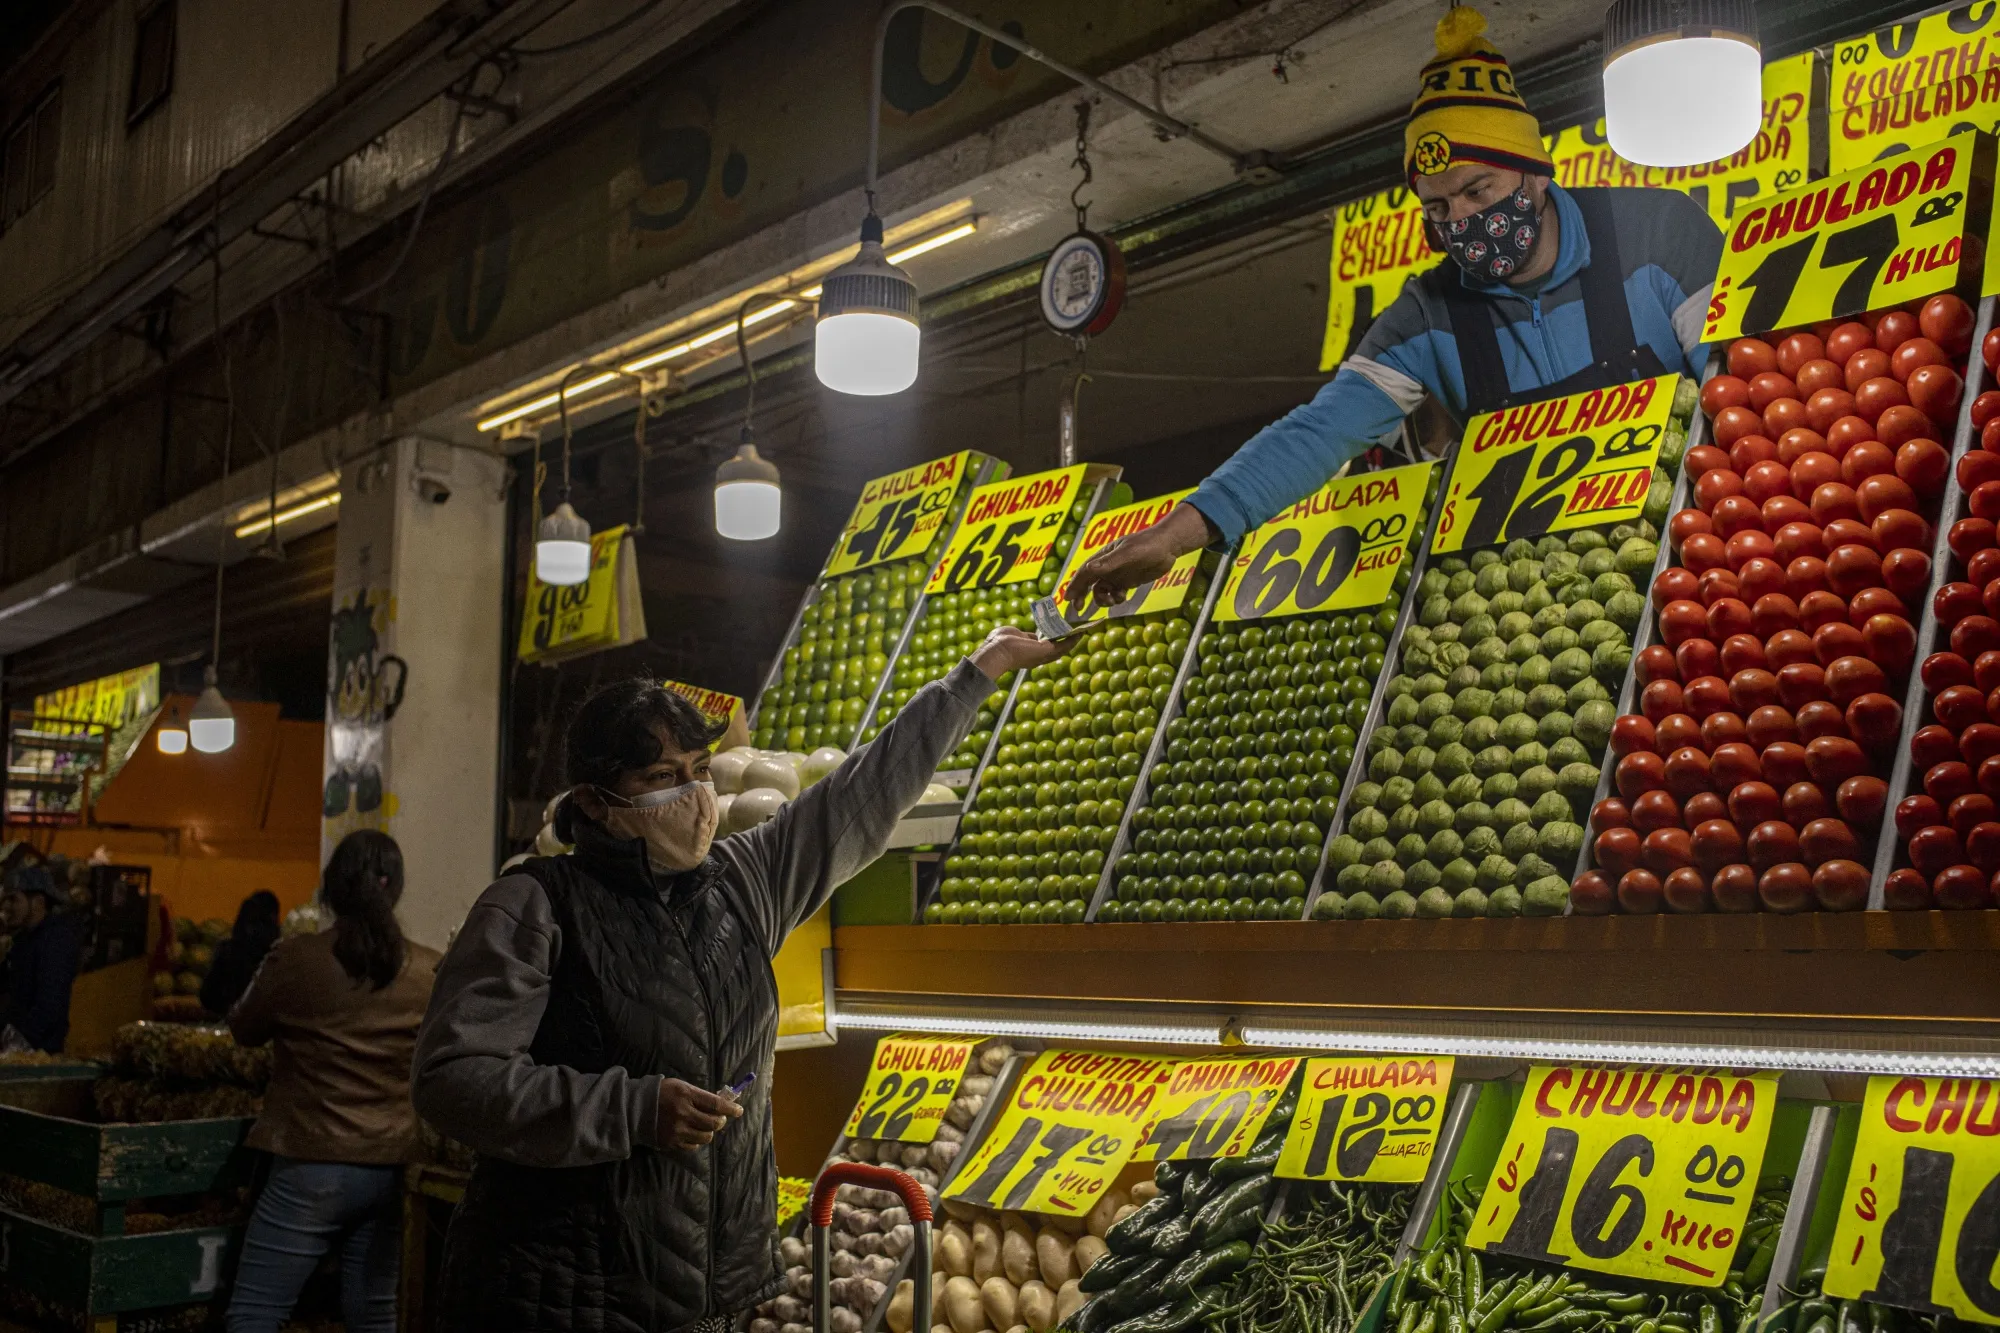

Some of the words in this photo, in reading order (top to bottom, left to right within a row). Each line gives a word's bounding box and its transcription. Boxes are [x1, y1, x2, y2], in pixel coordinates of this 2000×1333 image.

[1731, 147, 1957, 253] CHULADA
[1737, 212, 1899, 336] 17
[1883, 236, 1963, 285] KILO
[1474, 378, 1657, 453] CHULADA
[863, 454, 957, 505] CHULADA
[966, 474, 1070, 525] CHULADA
[1266, 476, 1400, 525] HULADA
[1461, 435, 1595, 549] 12
[1566, 468, 1652, 513] KILO
[846, 492, 923, 566] 45
[912, 512, 944, 537] KILO
[1083, 499, 1175, 550] CHULA
[945, 517, 1035, 591] 65
[1014, 542, 1053, 567] KILO
[1234, 525, 1361, 620] 60
[1354, 546, 1402, 578] KILO
[876, 1043, 967, 1073] CHULADA
[1169, 1059, 1295, 1096] CHULADA
[1313, 1059, 1437, 1091] CHULADA
[856, 1072, 929, 1141] 22
[1017, 1075, 1157, 1122] CHULADA
[1535, 1067, 1755, 1133] CHULADA
[1146, 1091, 1251, 1160] 40
[1304, 1092, 1391, 1178] 12
[1392, 1094, 1436, 1125] 00
[1376, 1141, 1432, 1158] CUARTO
[948, 1116, 1094, 1210] 17
[1058, 1171, 1104, 1195] KILO
[1486, 1126, 1655, 1265] 16
[1685, 1144, 1745, 1189] 00
[1660, 1209, 1734, 1251] KILO
